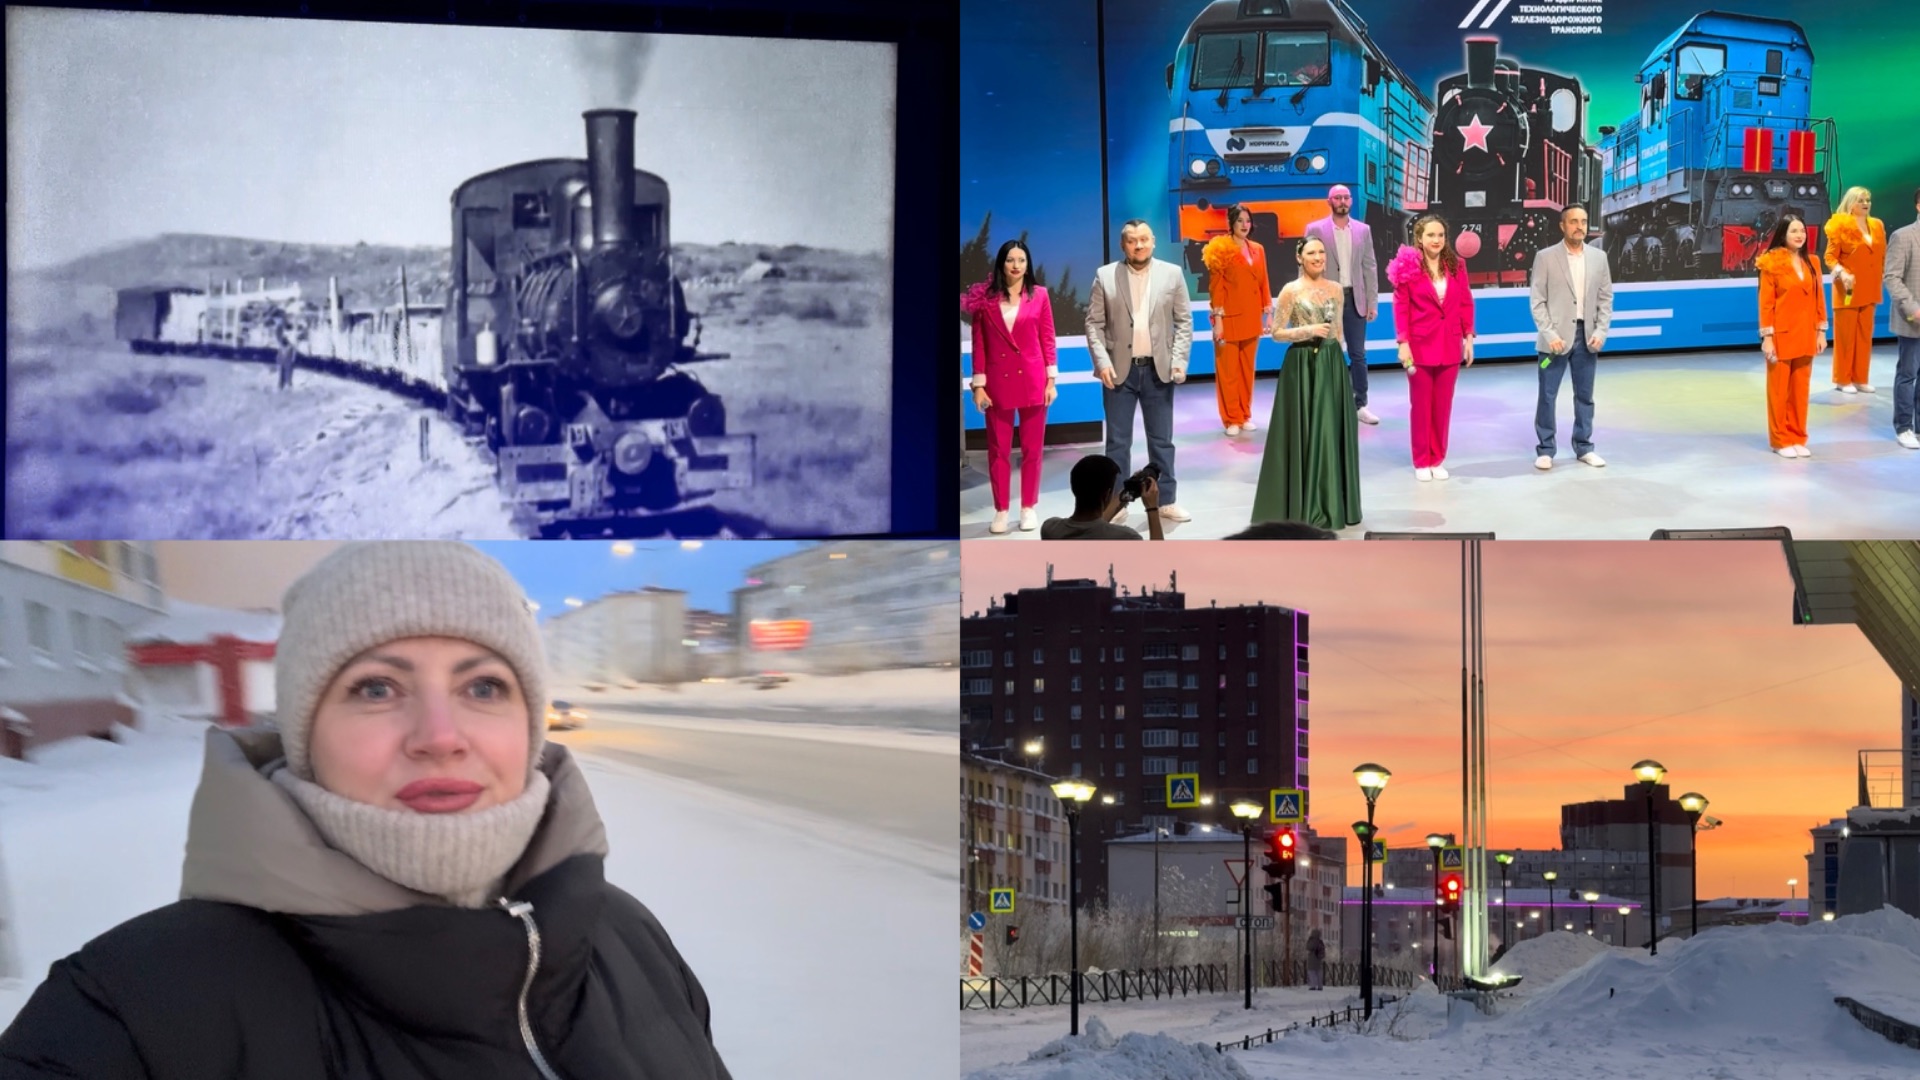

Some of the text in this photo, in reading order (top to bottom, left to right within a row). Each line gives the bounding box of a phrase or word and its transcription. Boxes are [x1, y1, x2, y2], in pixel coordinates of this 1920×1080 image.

[1519, 5, 1603, 13] ТЕХНОЛОГИЧЕСКОГО
[1511, 15, 1603, 24] ЖЕЛЕЗНОДОРОЖНОГО
[1550, 26, 1603, 34] ТРАНСПОРТА
[1461, 223, 1482, 233] 274
